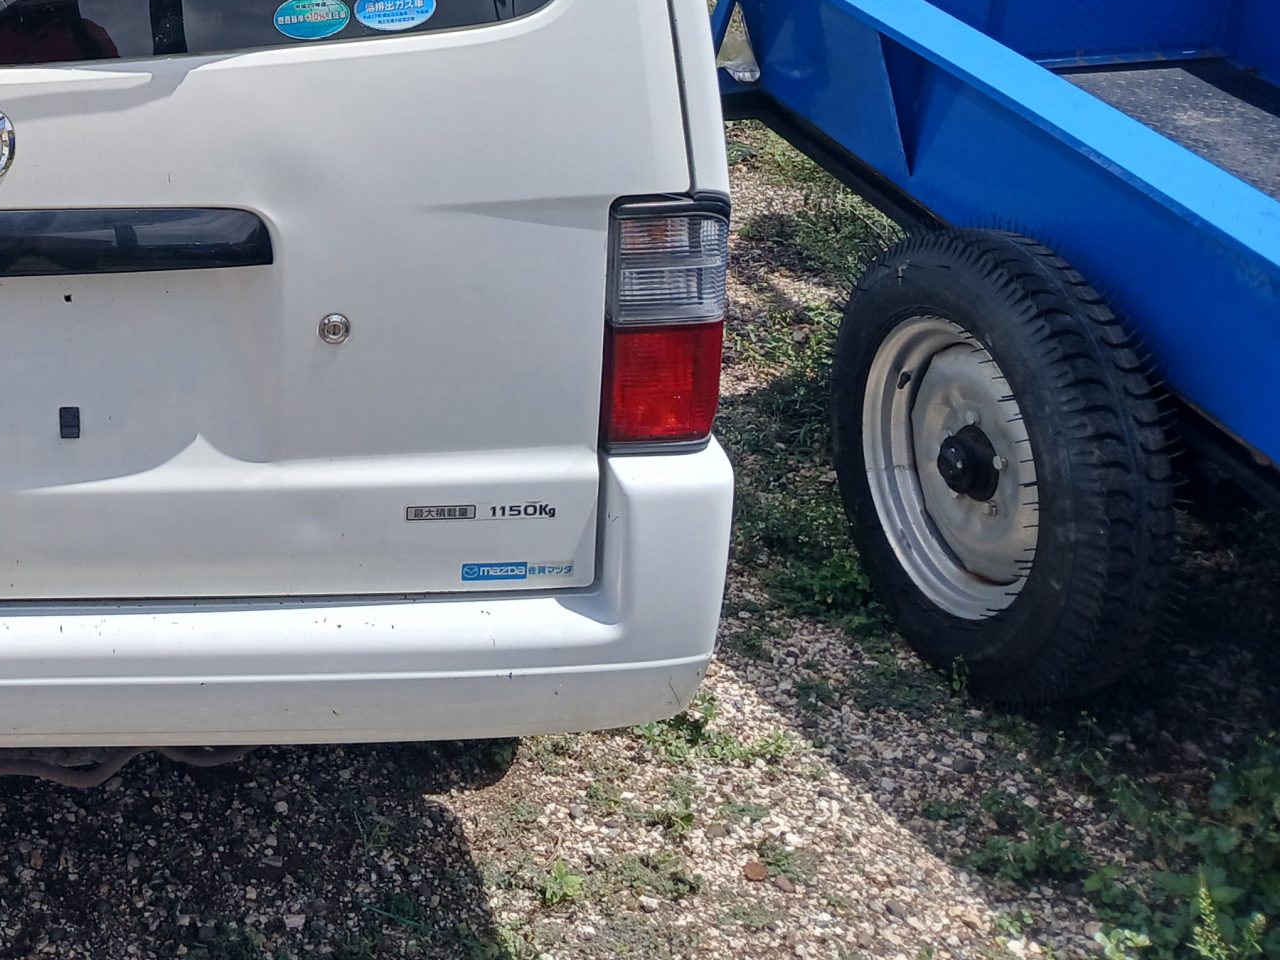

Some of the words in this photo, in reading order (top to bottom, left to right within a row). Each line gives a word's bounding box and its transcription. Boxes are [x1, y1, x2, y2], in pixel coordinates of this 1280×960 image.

[412, 507, 470, 519] 最大積載量
[489, 503, 556, 518] 1150Kg
